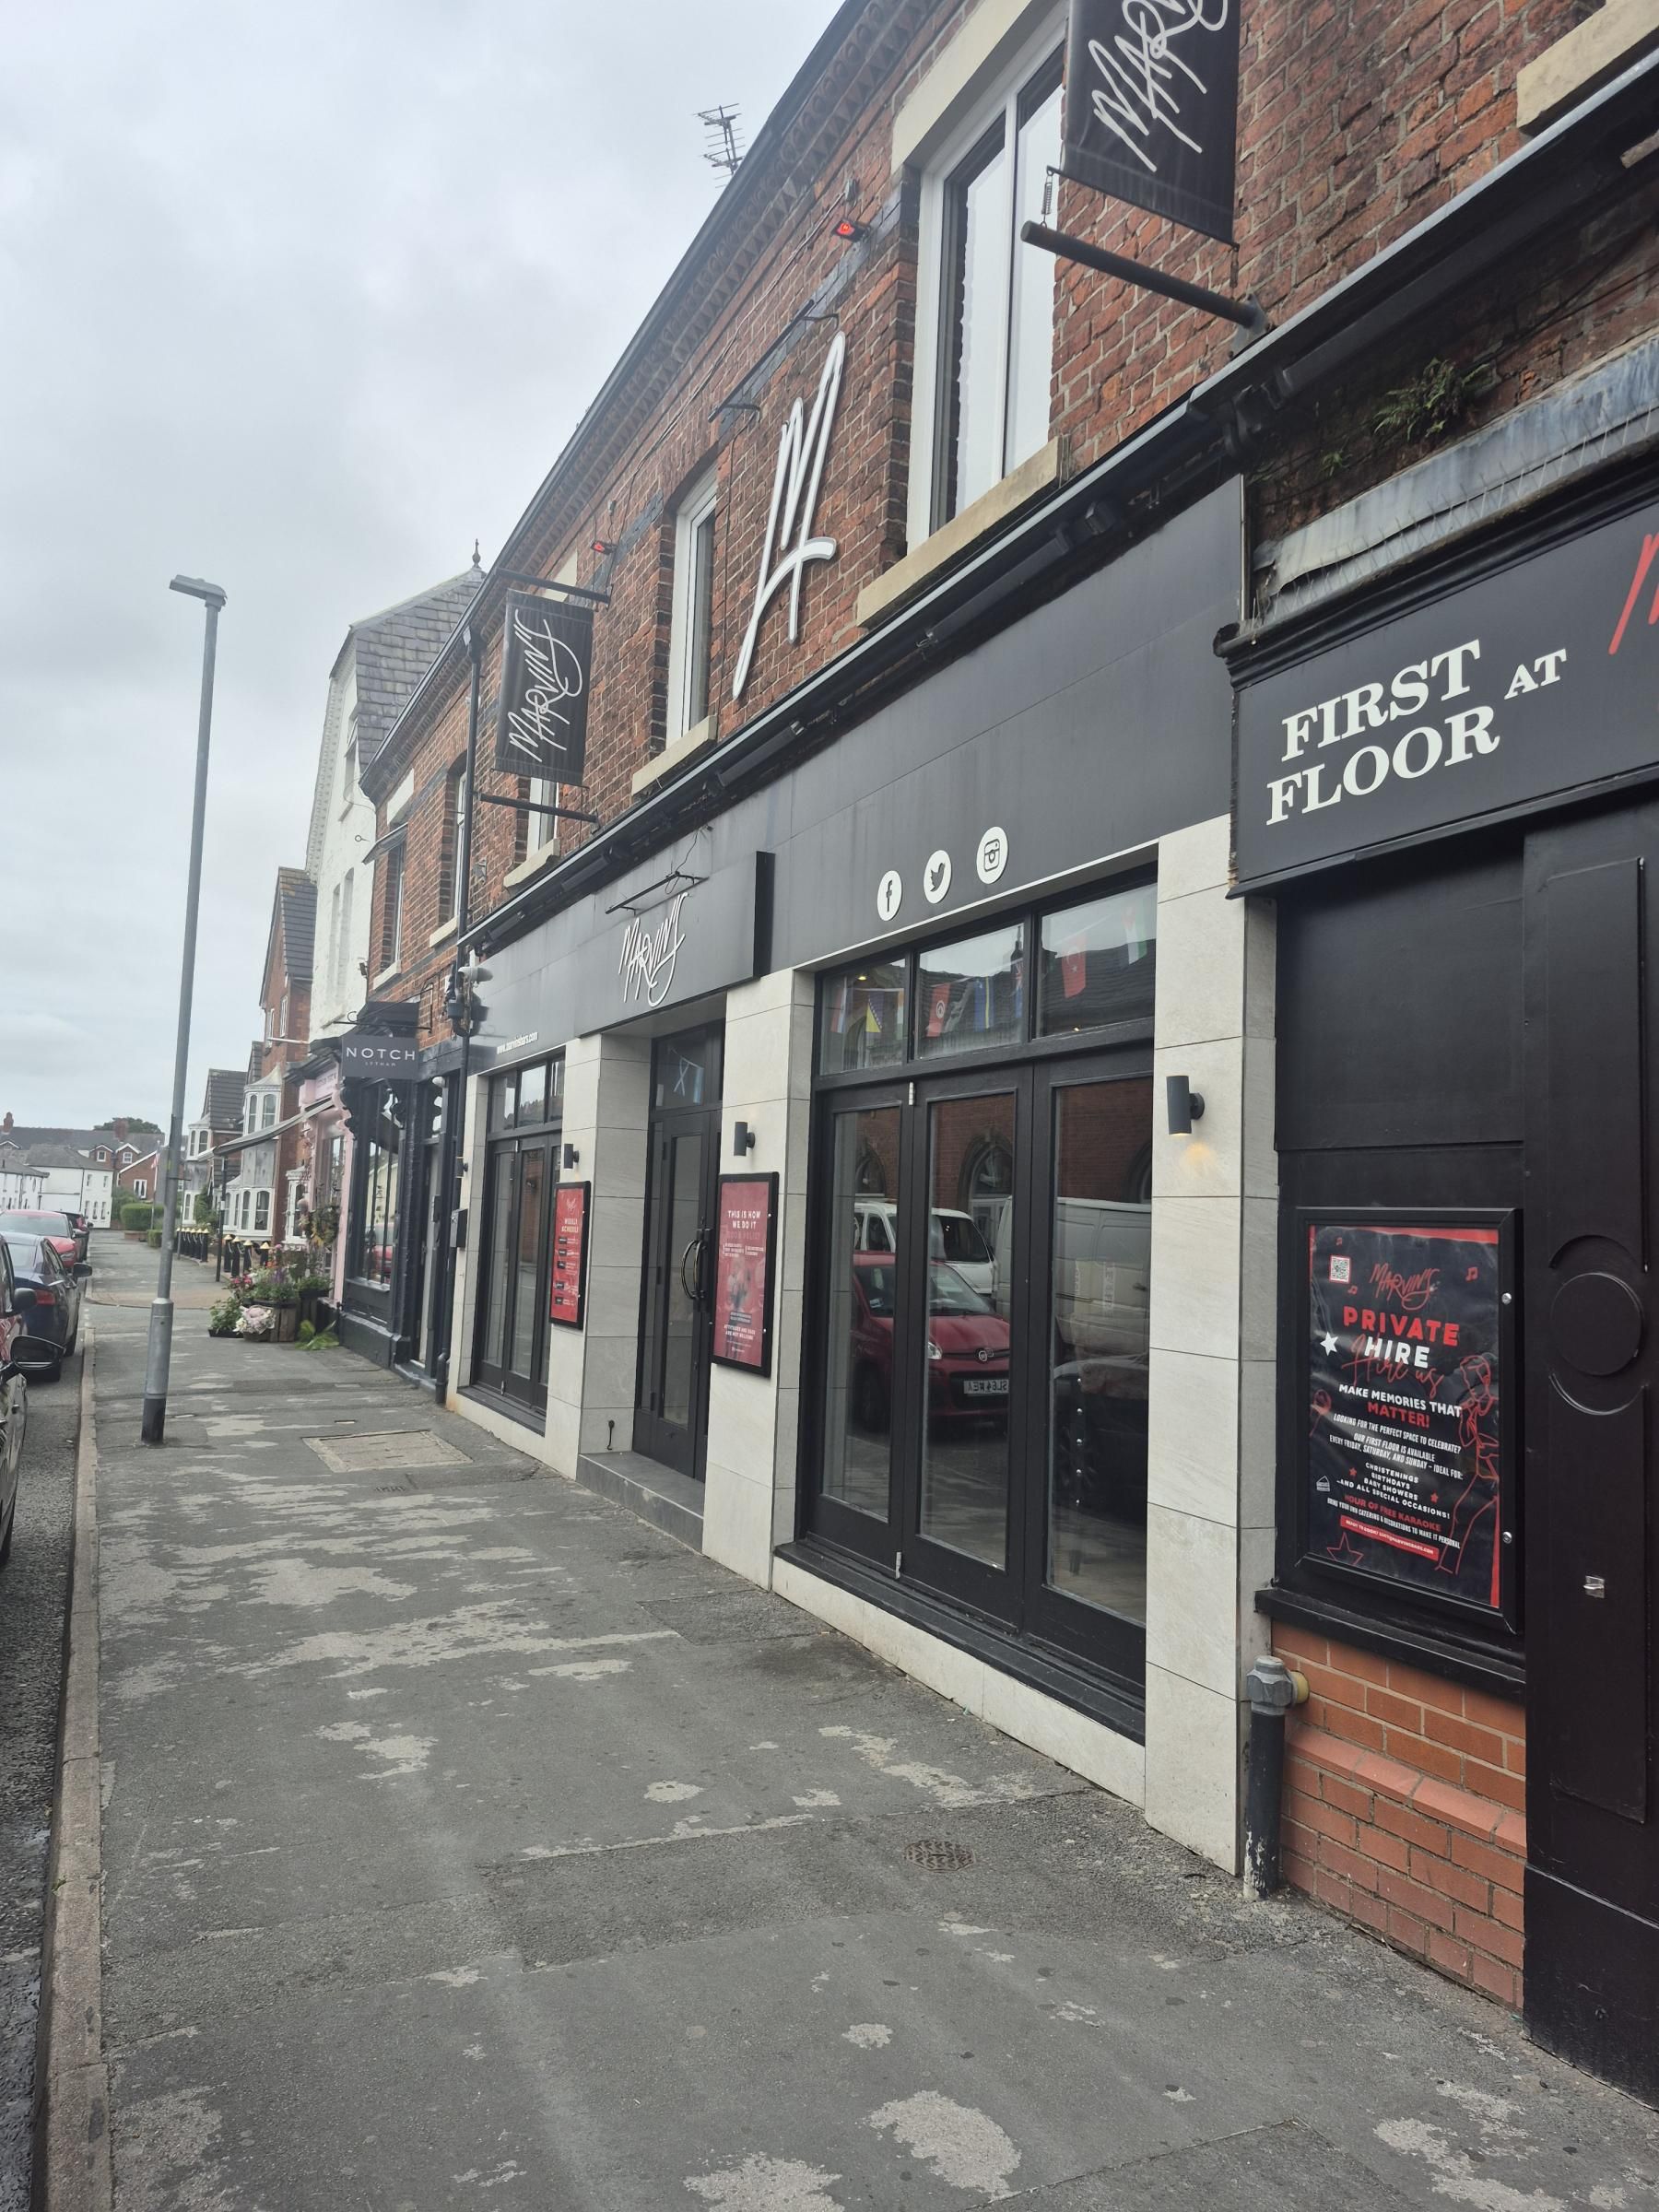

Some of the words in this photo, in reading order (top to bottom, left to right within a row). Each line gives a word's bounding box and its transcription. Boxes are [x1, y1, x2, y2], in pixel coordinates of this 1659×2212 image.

[1504, 648, 1567, 700] AT
[1281, 639, 1480, 762] FIRST
[1265, 705, 1500, 825] FLOOR
[346, 1047, 415, 1061] NOTCH
[728, 1210, 740, 1218] THIS
[741, 1210, 747, 1218] IS
[748, 1210, 760, 1218] HOW
[732, 1220, 741, 1229] WE
[742, 1220, 749, 1229] DO
[750, 1220, 757, 1229] IT
[1343, 1306, 1460, 1347] PRIVATE
[1364, 1336, 1430, 1369] HIRE
[1339, 1384, 1369, 1397] MAKE
[1371, 1390, 1427, 1410] MEMORIES
[1430, 1401, 1462, 1418] THAT
[1368, 1402, 1430, 1429] MATTER!
[1334, 1413, 1357, 1426] LOOKING
[1357, 1419, 1369, 1430] FOR
[1369, 1422, 1379, 1431] THE
[1380, 1425, 1402, 1438] PERFECT
[1403, 1430, 1419, 1442] SPACE
[1420, 1436, 1427, 1444] TO
[1428, 1438, 1462, 1453] CELEBRATE?
[1353, 1432, 1365, 1441] OUR
[1365, 1436, 1382, 1446] FIRST
[1382, 1441, 1400, 1452] FLOOR
[1401, 1445, 1406, 1453] IS
[1406, 1447, 1435, 1462] AVAILABLE
[1329, 1434, 1344, 1445] EVERY
[1344, 1439, 1362, 1452] FRIDAY,
[1363, 1444, 1391, 1460] SATURDAY,
[1393, 1453, 1405, 1463] AND
[1406, 1456, 1428, 1469] SUNDAY
[1433, 1465, 1449, 1477] IDEAL
[1365, 1462, 1419, 1483] CHRISTENINGS
[1364, 1477, 1381, 1488] BABY
[1382, 1485, 1418, 1500] SHOWERS
[1371, 1472, 1410, 1489] BIRTHDAYS
[1344, 1495, 1366, 1507] HOUR
[1368, 1501, 1379, 1510] OF
[1380, 1505, 1397, 1518] FREE
[1398, 1512, 1441, 1531] KARAOKE
[1357, 1484, 1370, 1493] ALL
[1372, 1488, 1400, 1503] SPECIAL
[1402, 1500, 1450, 1519] OCCASIONS!
[1359, 1509, 1380, 1521] CATERING
[1438, 1535, 1461, 1548] PERSONAL
